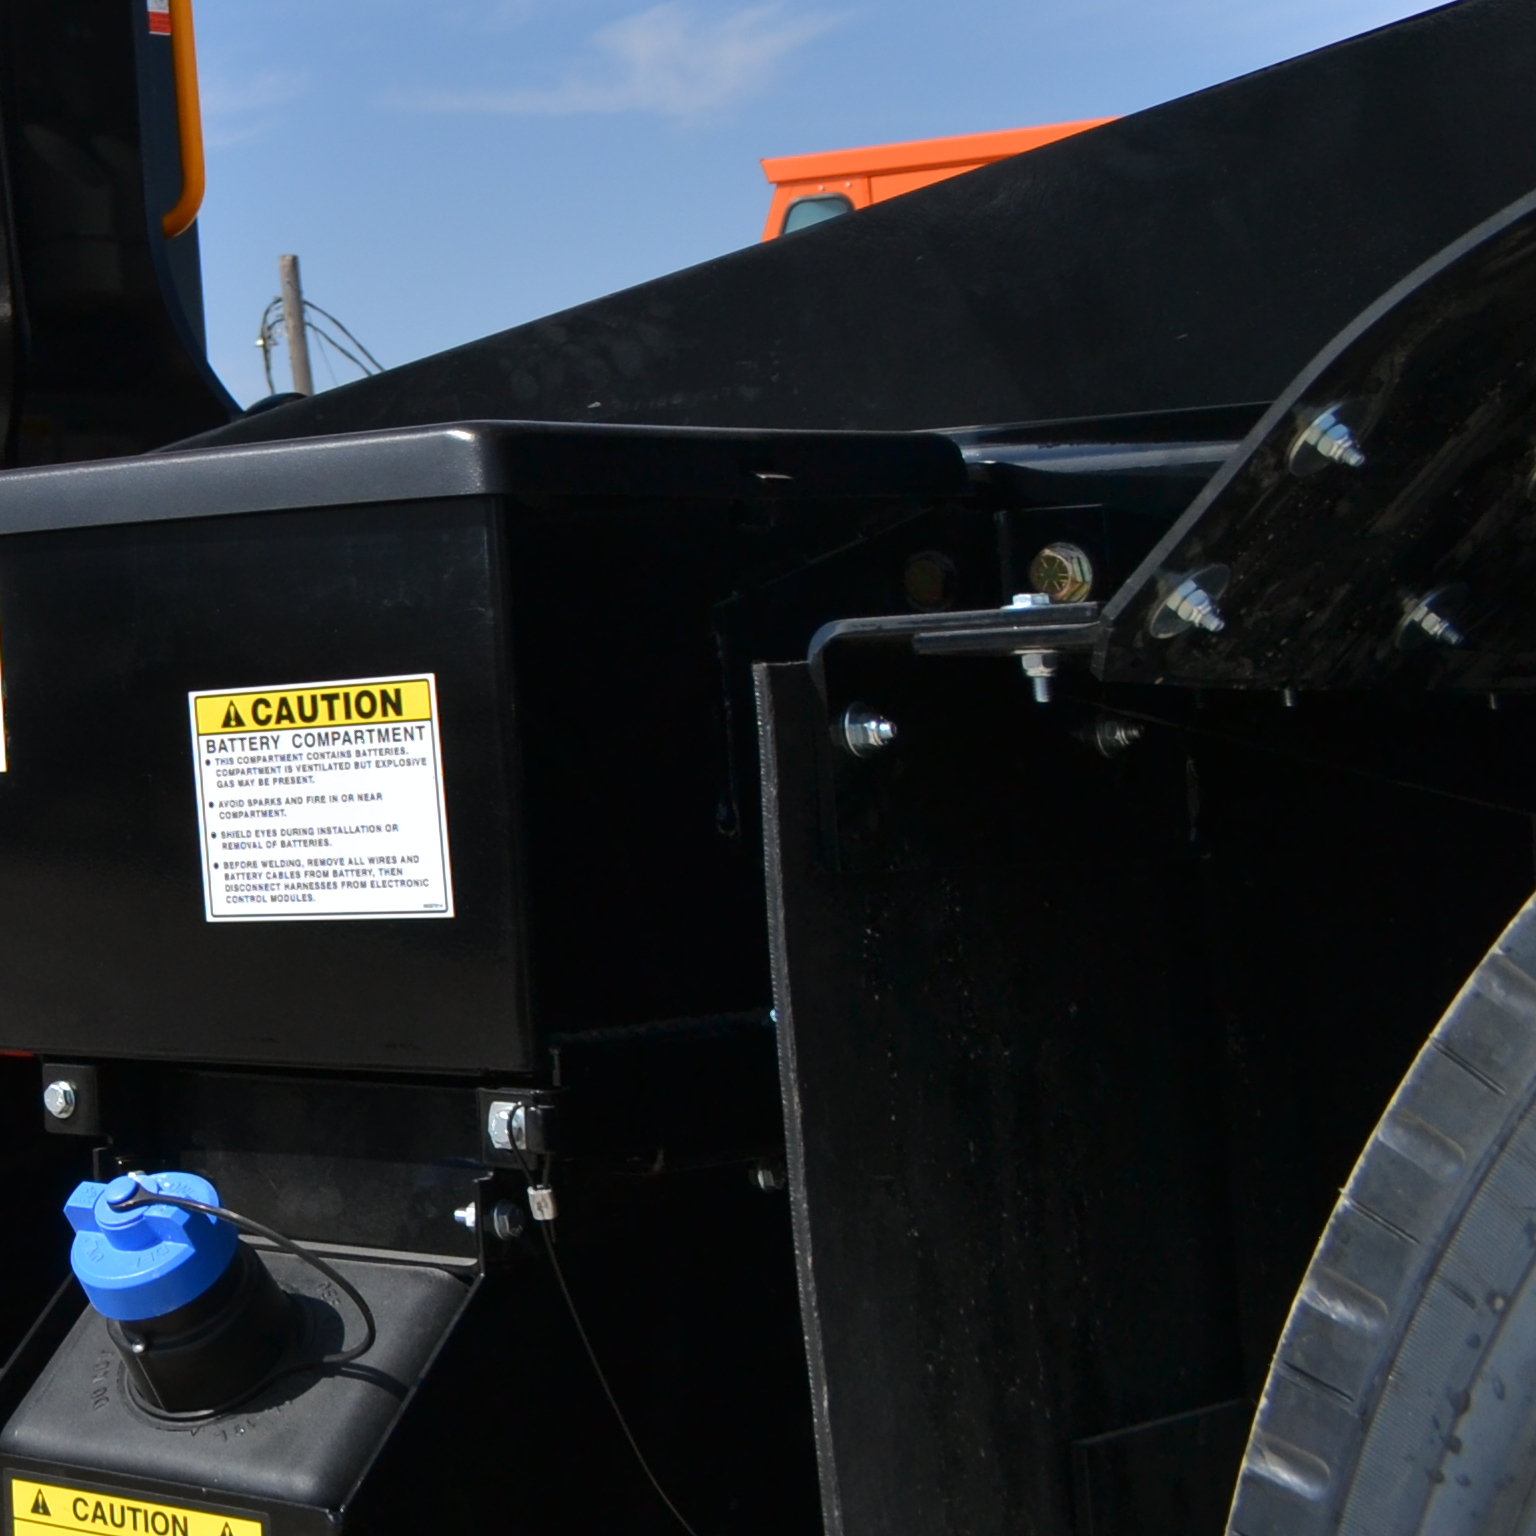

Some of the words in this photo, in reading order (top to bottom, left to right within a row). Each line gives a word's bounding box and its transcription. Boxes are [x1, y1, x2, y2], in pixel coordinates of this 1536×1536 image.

[250, 687, 404, 727] CAUTION
[206, 734, 280, 754] BATTERY
[291, 725, 425, 749] COMPARTMENT
[215, 757, 235, 766] THIS
[237, 753, 303, 765] COMPARTMENT
[306, 749, 352, 761] CONTAINS
[355, 746, 409, 758] BATTERIES.
[216, 765, 282, 777] COMPARTMENT
[284, 765, 293, 773] IS
[295, 761, 351, 773] VENTILATED
[354, 760, 372, 770] BUT
[375, 757, 428, 769] EXPLOSIVE
[216, 779, 235, 789] GAS
[237, 778, 255, 788] MAY
[258, 778, 270, 786] BE
[272, 775, 316, 786] PRESENT.
[218, 799, 245, 809] AVOID
[247, 797, 282, 807] SPARKS
[284, 796, 303, 805] AND
[306, 795, 326, 804] FIRE
[328, 795, 338, 803] IN
[341, 794, 354, 803] OR
[357, 792, 383, 802] NEAR
[219, 809, 287, 820] COMPARTMENT.
[220, 829, 252, 839] SHIELD
[254, 828, 278, 838] EYES
[280, 827, 315, 837] DURING
[317, 824, 382, 835] INSTALLATION
[385, 823, 399, 833] OR
[222, 841, 263, 850] REMOVAL
[265, 840, 278, 849] OF
[280, 838, 333, 848] BATTERIES.
[223, 860, 258, 870] BEFORE
[261, 859, 305, 869] WELDING,
[307, 857, 345, 867] REMOVE
[347, 856, 365, 865] ALL
[367, 855, 397, 865] WIRES
[400, 855, 420, 864] AND
[224, 871, 263, 881] BATTERY
[265, 870, 301, 880] CABLES
[304, 869, 329, 879] FROM
[332, 868, 375, 878] BATTERY,
[378, 867, 403, 877] THEN
[225, 882, 281, 893] DISCONNECT
[284, 881, 338, 891] HARNESSES
[341, 880, 367, 890] FROM
[370, 878, 430, 889] ELECTRONIC
[225, 894, 268, 904] CONTROL
[270, 893, 316, 903] MODULES.
[72, 1496, 189, 1536] CAUTION
